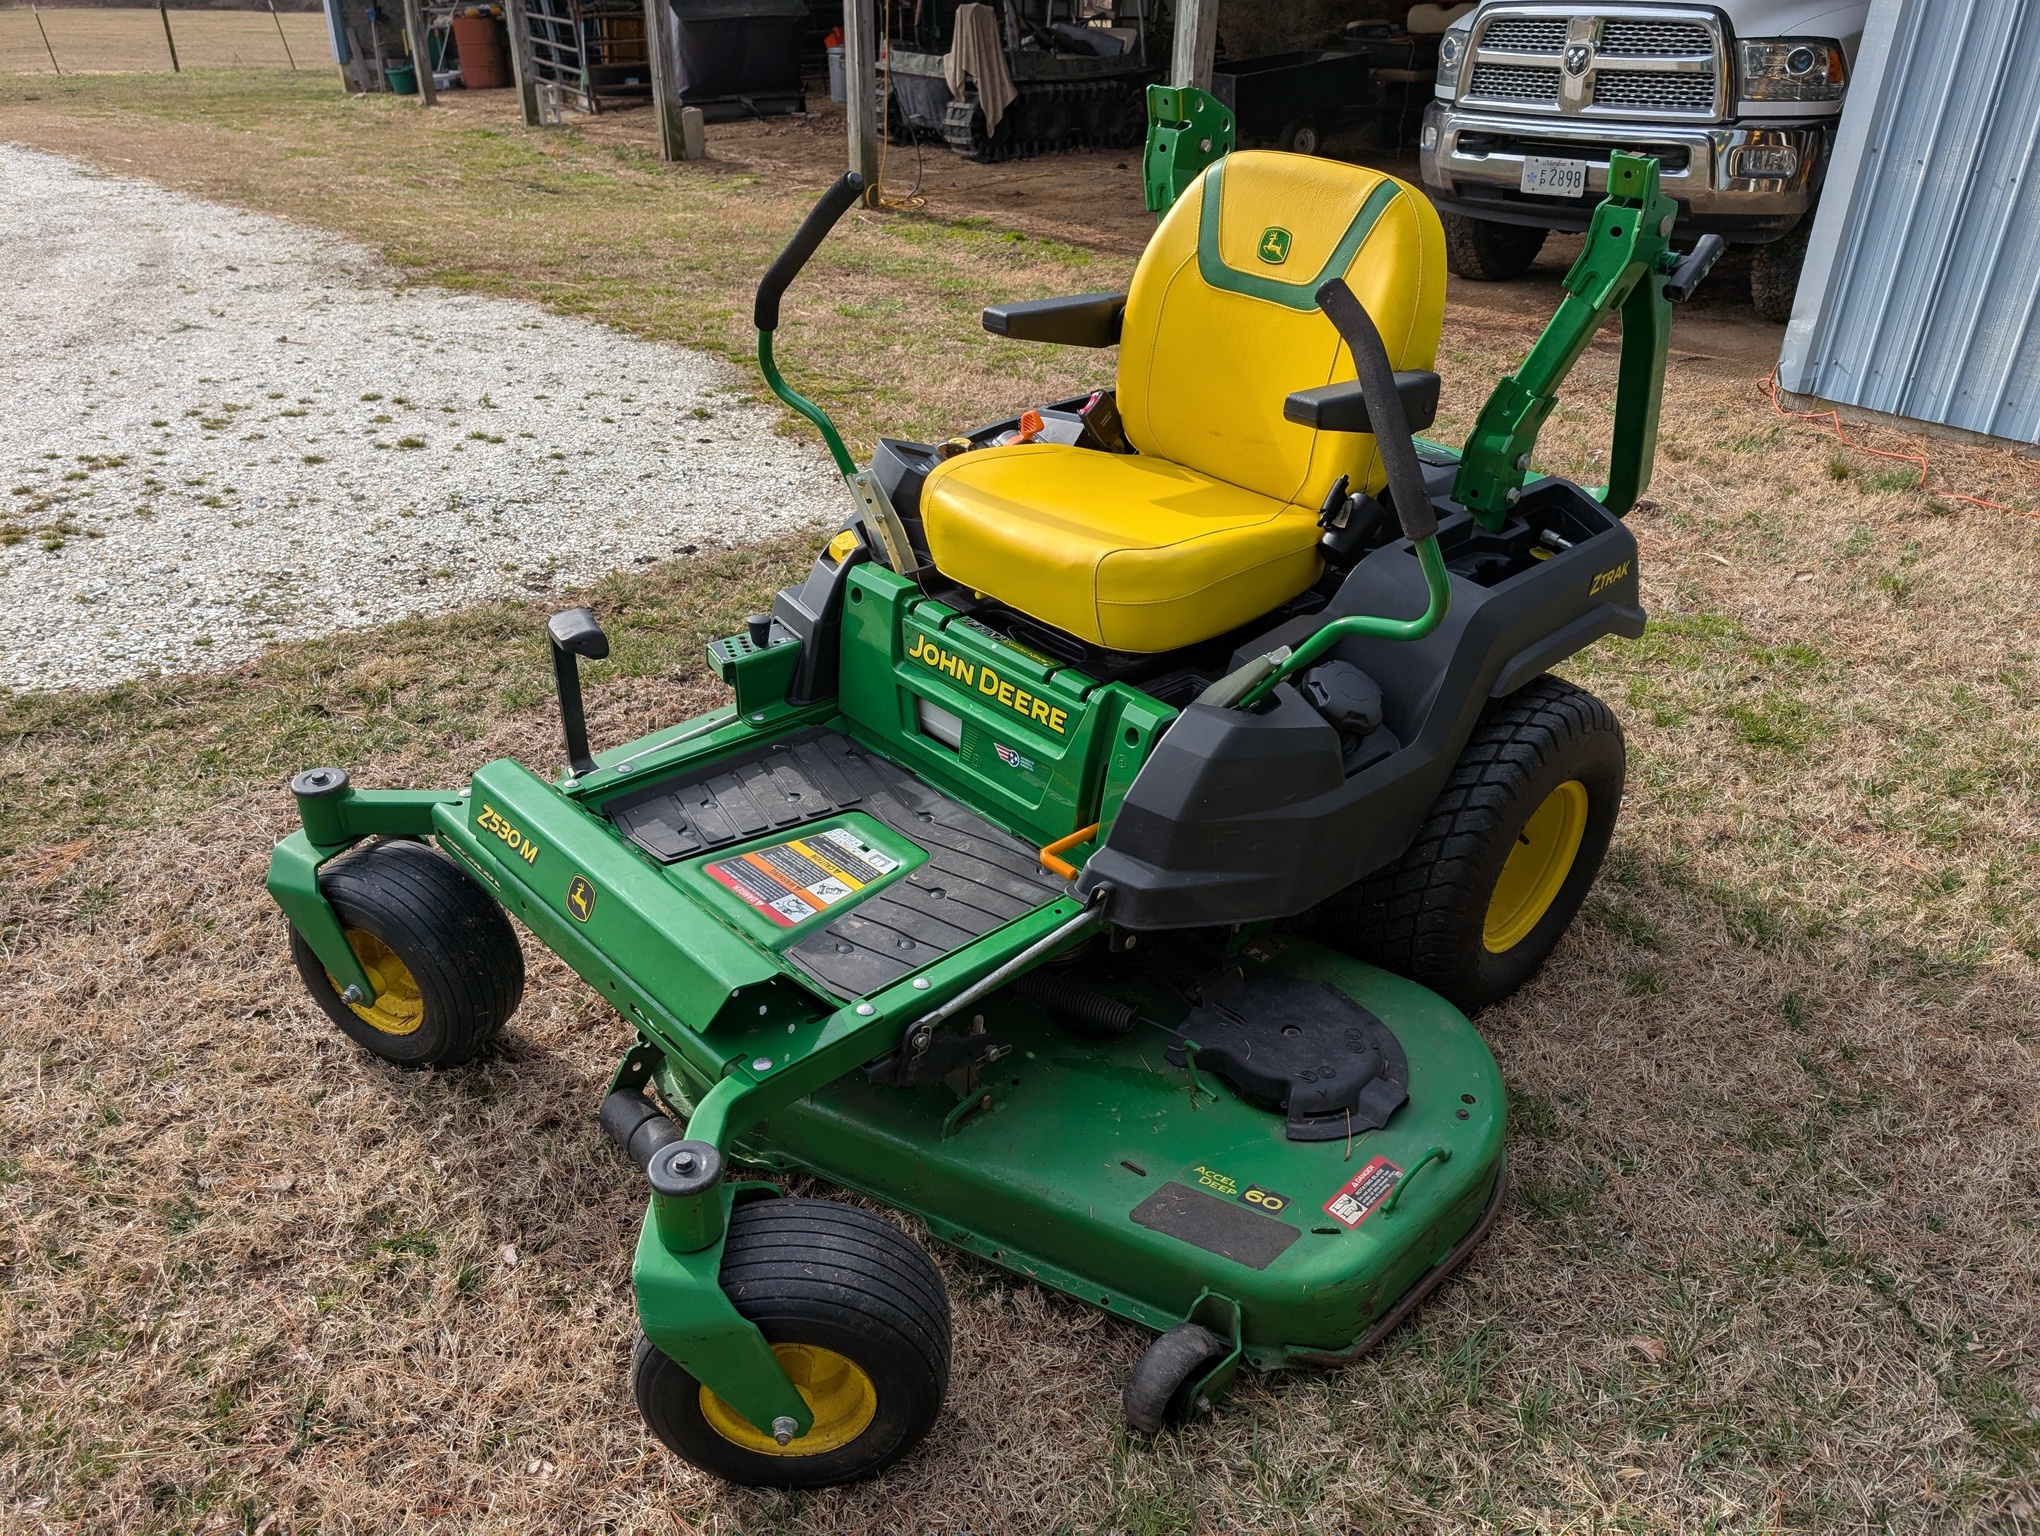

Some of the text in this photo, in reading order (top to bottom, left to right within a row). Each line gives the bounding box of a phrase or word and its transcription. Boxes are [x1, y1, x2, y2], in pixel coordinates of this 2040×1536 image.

[1549, 168, 1581, 188] 2898
[1589, 560, 1631, 596] ZTRAK
[908, 634, 975, 686] JOHN
[978, 666, 1068, 735] DEERE
[476, 803, 539, 864] Z530 M
[809, 852, 835, 872] CAUTION
[768, 868, 800, 891] WARNING
[732, 884, 759, 904] DANGER
[1193, 1165, 1237, 1188] ACCEL
[1354, 1167, 1385, 1196] ROTATING BLADE
[1355, 1164, 1375, 1184] DANGER
[1198, 1176, 1237, 1195] DEEP
[1244, 1190, 1284, 1210] 60
